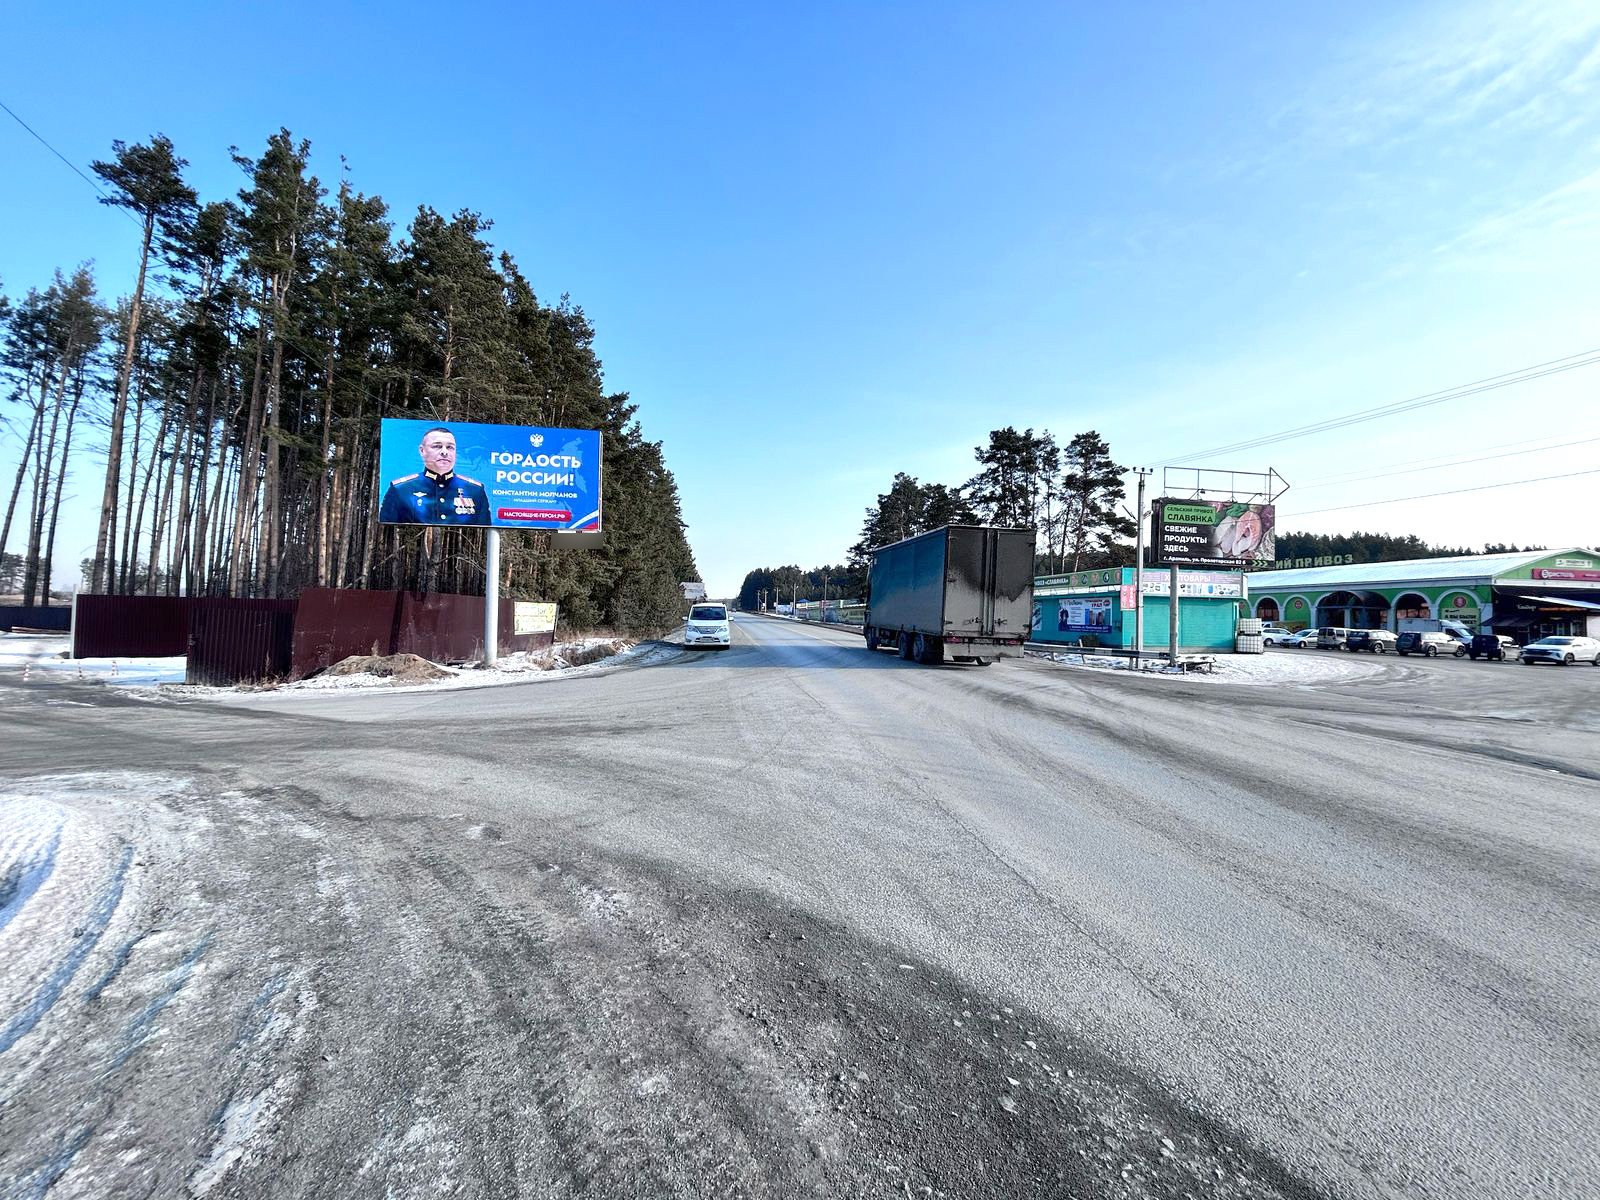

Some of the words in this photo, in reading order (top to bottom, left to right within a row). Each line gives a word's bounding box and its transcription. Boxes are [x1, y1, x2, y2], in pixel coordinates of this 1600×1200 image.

[490, 452, 581, 468] ГОРДОСТЬ
[496, 470, 575, 486] РОССИИ!
[492, 489, 538, 497] КОНСТАНТИН
[539, 491, 578, 499] МОЛЧАНОВ
[1167, 513, 1213, 523] СЛАВЯНКА
[1164, 525, 1198, 533] СВЕЖИЕ
[1164, 535, 1208, 544] ПРОДУКТЫ
[1163, 544, 1189, 552] ЗДЕСЬ
[1296, 554, 1353, 568] ПРИВОЗ
